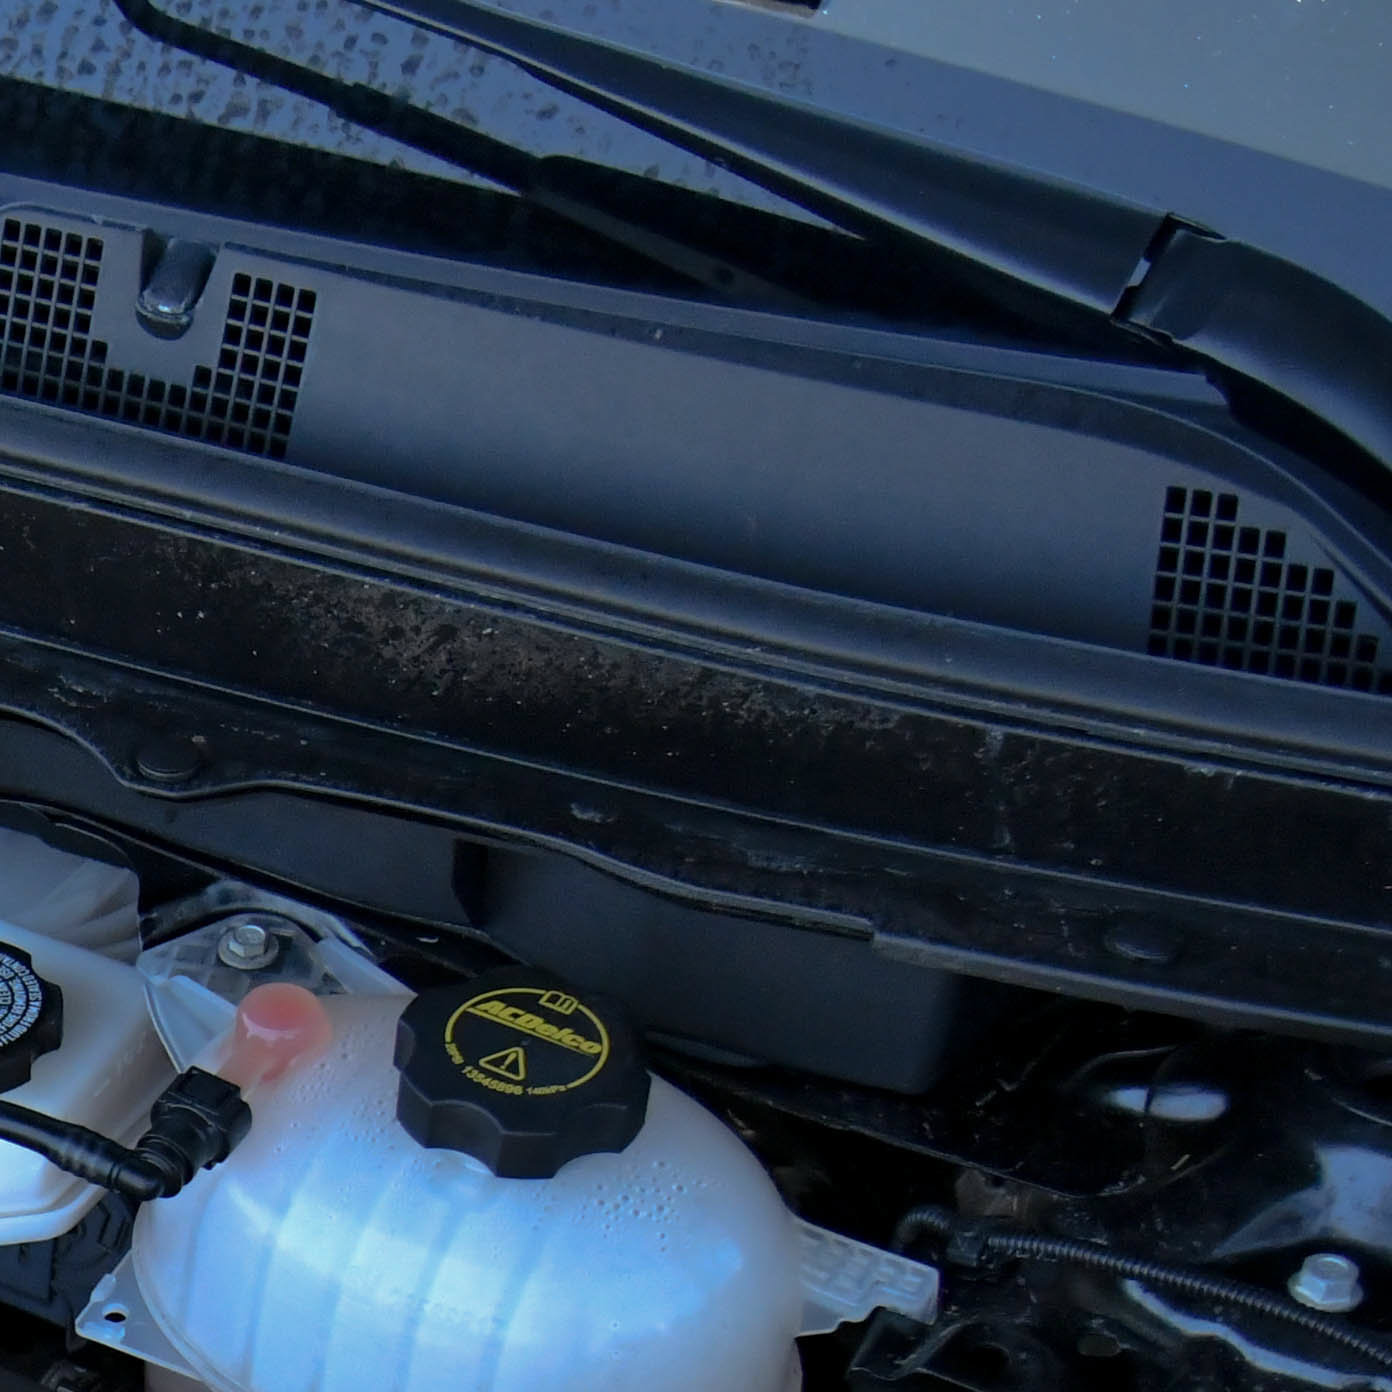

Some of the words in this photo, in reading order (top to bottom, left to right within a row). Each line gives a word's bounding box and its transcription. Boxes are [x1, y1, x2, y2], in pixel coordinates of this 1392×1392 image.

[20, 975, 42, 999] SEALED
[21, 1006, 42, 1027] FROM
[476, 1000, 602, 1054] ACDelco
[1, 1025, 31, 1045] FLUID
